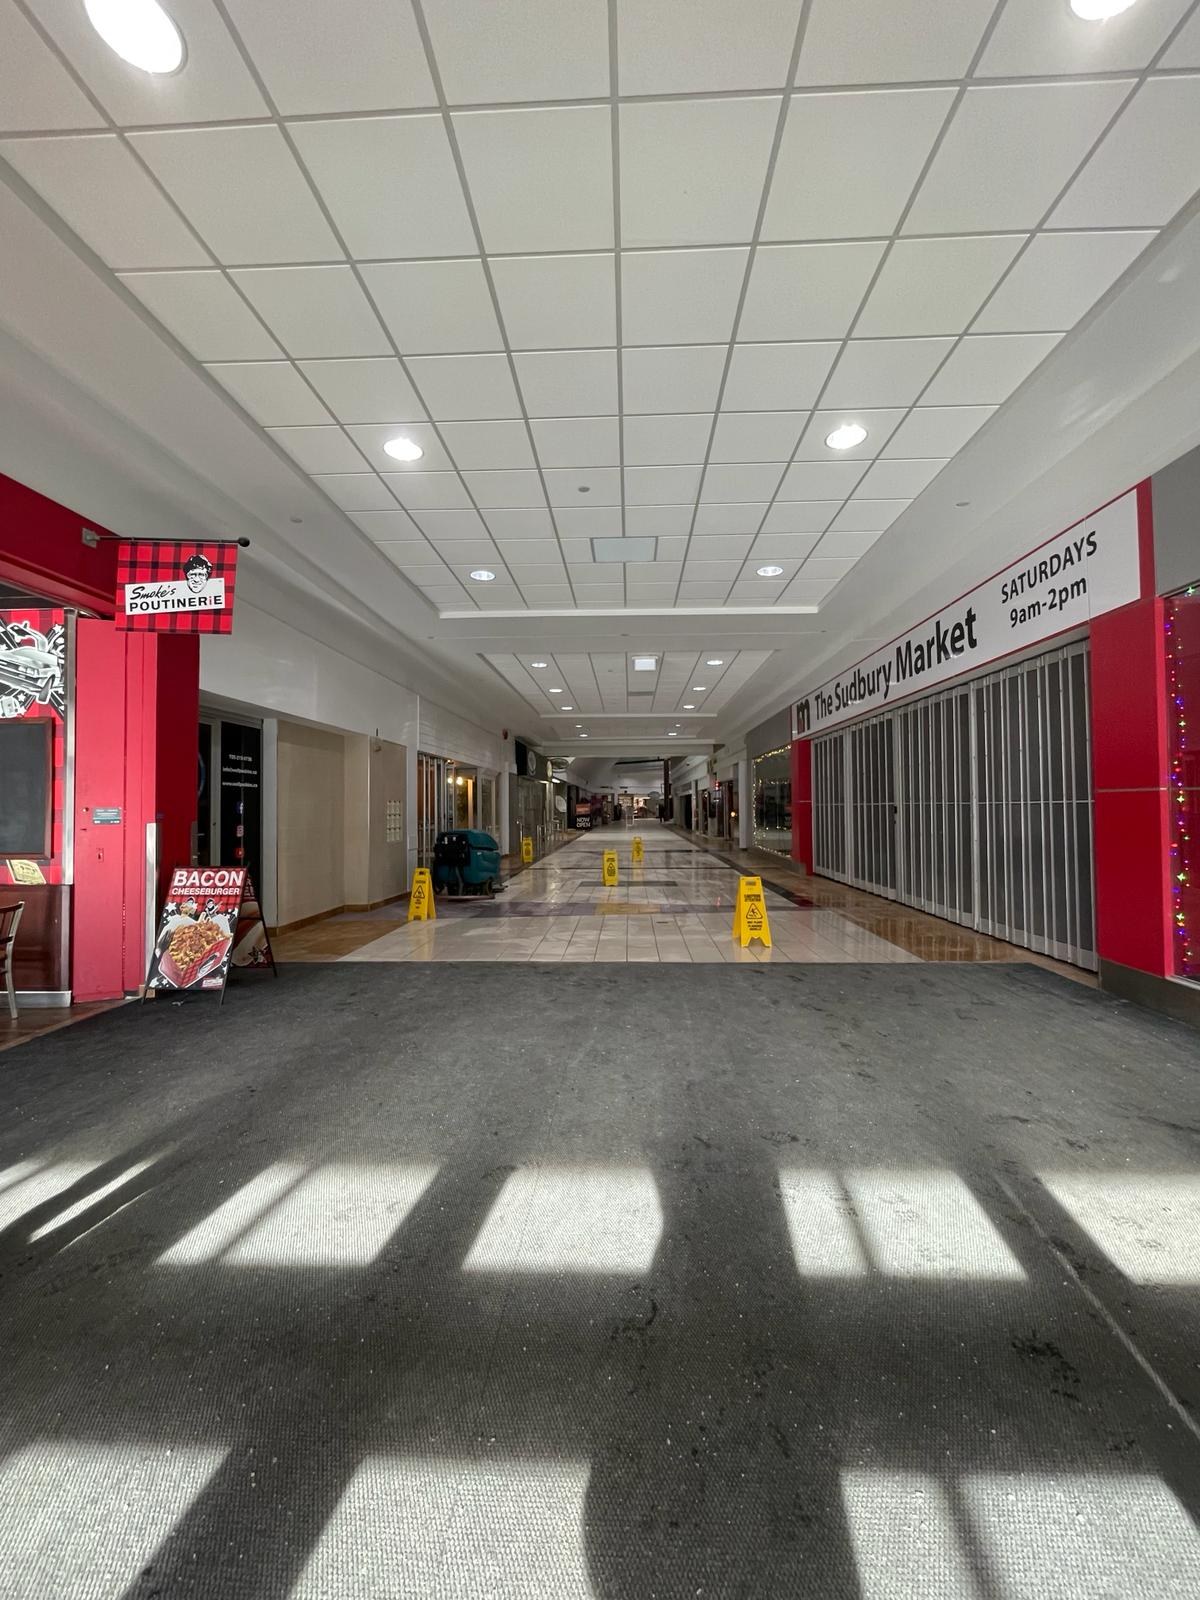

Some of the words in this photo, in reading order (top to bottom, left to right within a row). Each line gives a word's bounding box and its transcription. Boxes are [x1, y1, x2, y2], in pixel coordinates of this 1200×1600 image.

[1001, 530, 1098, 605] SATURDAYS
[129, 585, 177, 601] Smoke's
[1009, 577, 1088, 629] 9am-2pm
[814, 691, 833, 721] The
[834, 661, 892, 712] Sudbury
[895, 606, 978, 684] Market
[171, 887, 240, 896] CHEESEBURGER
[173, 870, 244, 887] BACON
